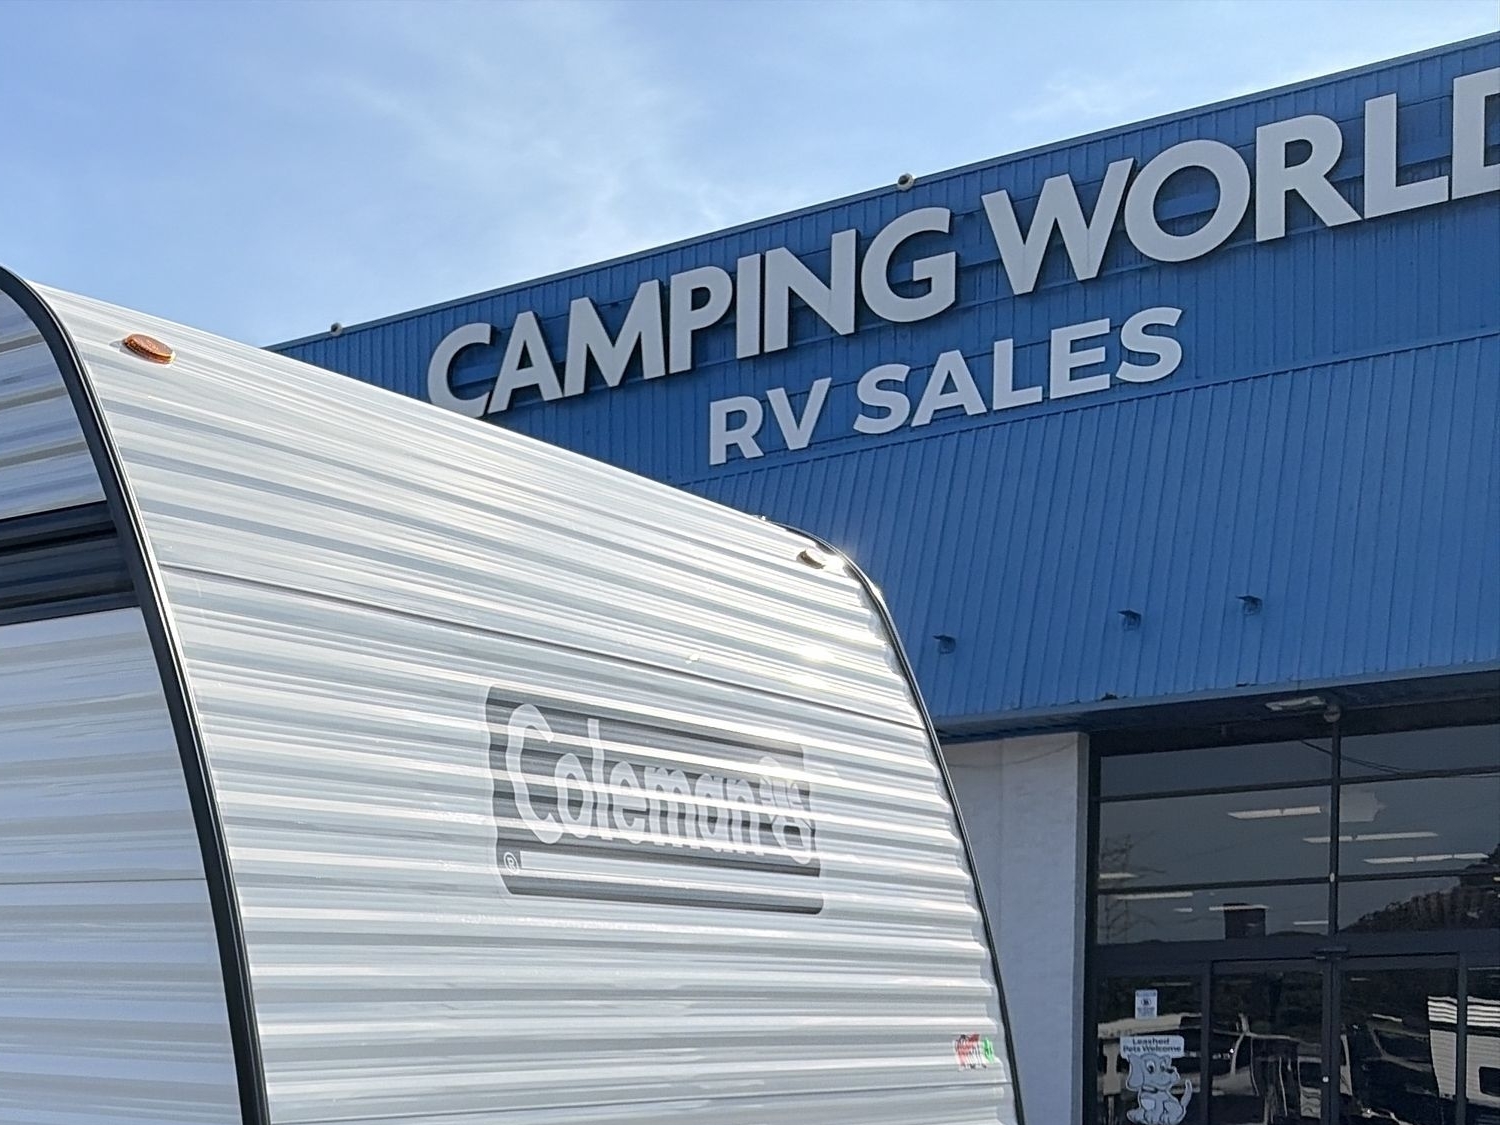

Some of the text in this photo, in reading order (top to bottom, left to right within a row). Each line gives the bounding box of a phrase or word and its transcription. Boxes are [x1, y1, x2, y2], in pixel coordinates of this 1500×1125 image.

[427, 207, 958, 419] CAMPING
[709, 306, 1184, 466] RV SALES
[505, 703, 765, 857] Coleman
[1122, 1045, 1182, 1053] Pets Welcome
[1132, 1037, 1170, 1045] Leashed
